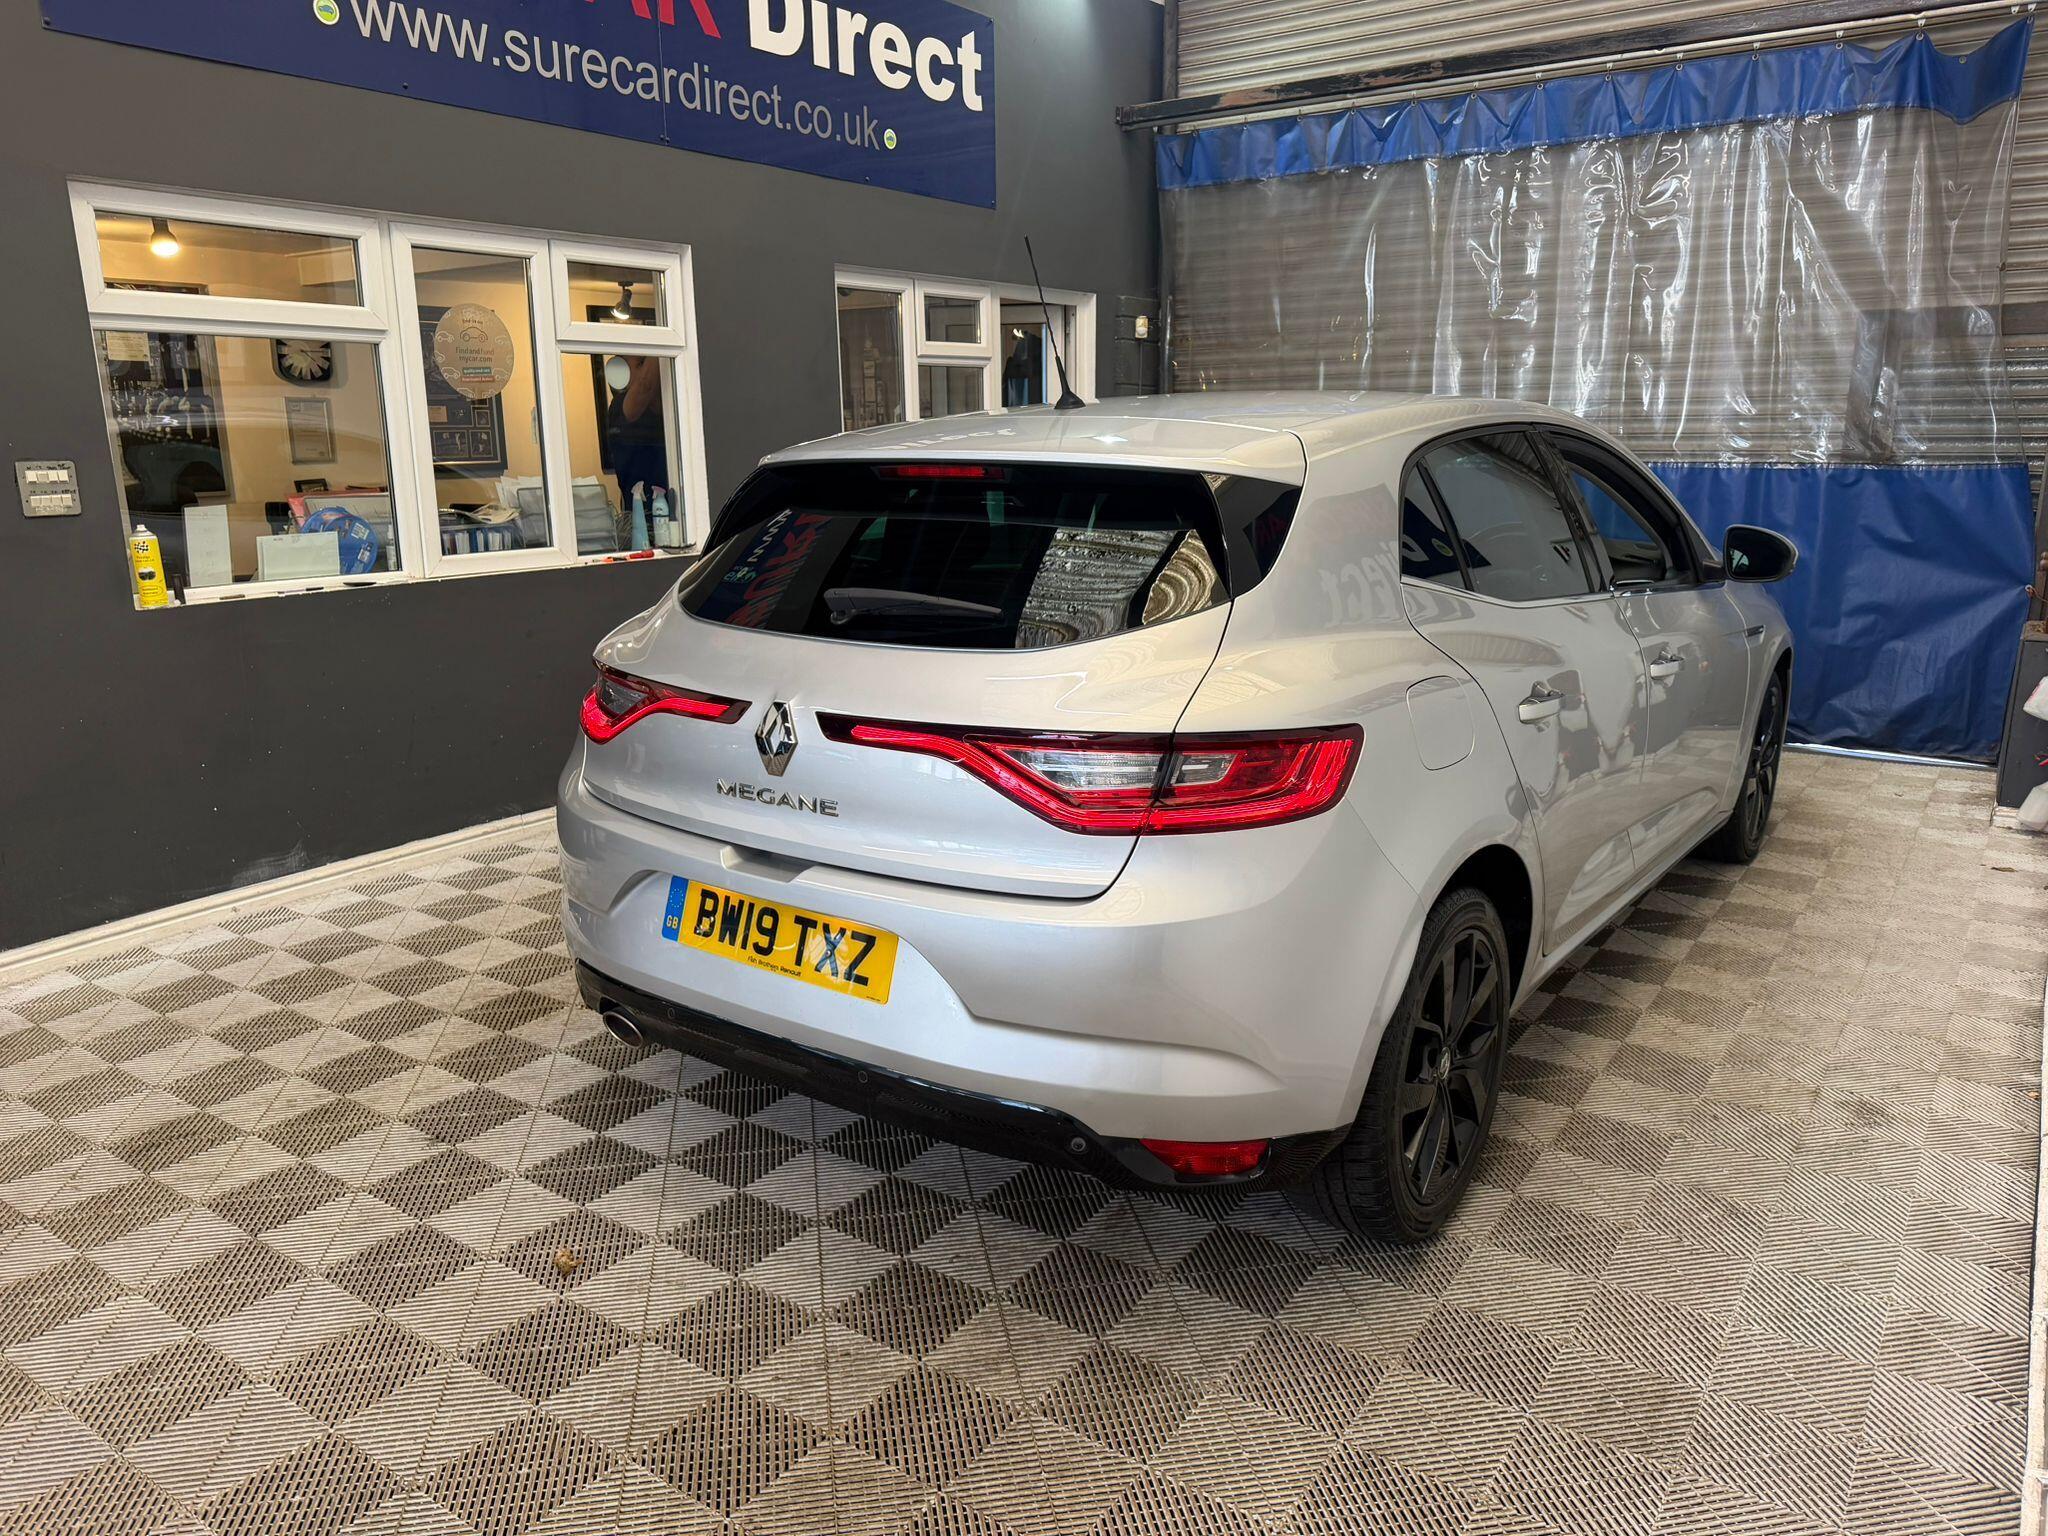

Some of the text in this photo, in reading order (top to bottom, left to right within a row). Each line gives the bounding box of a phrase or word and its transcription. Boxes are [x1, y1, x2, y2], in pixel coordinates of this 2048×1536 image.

[349, 0, 881, 151] www.surecardirect.co.uk
[748, 0, 983, 112] Direct
[716, 778, 840, 817] MEGANE
[666, 915, 679, 929] GB
[693, 888, 877, 987] BW19 TXZ
